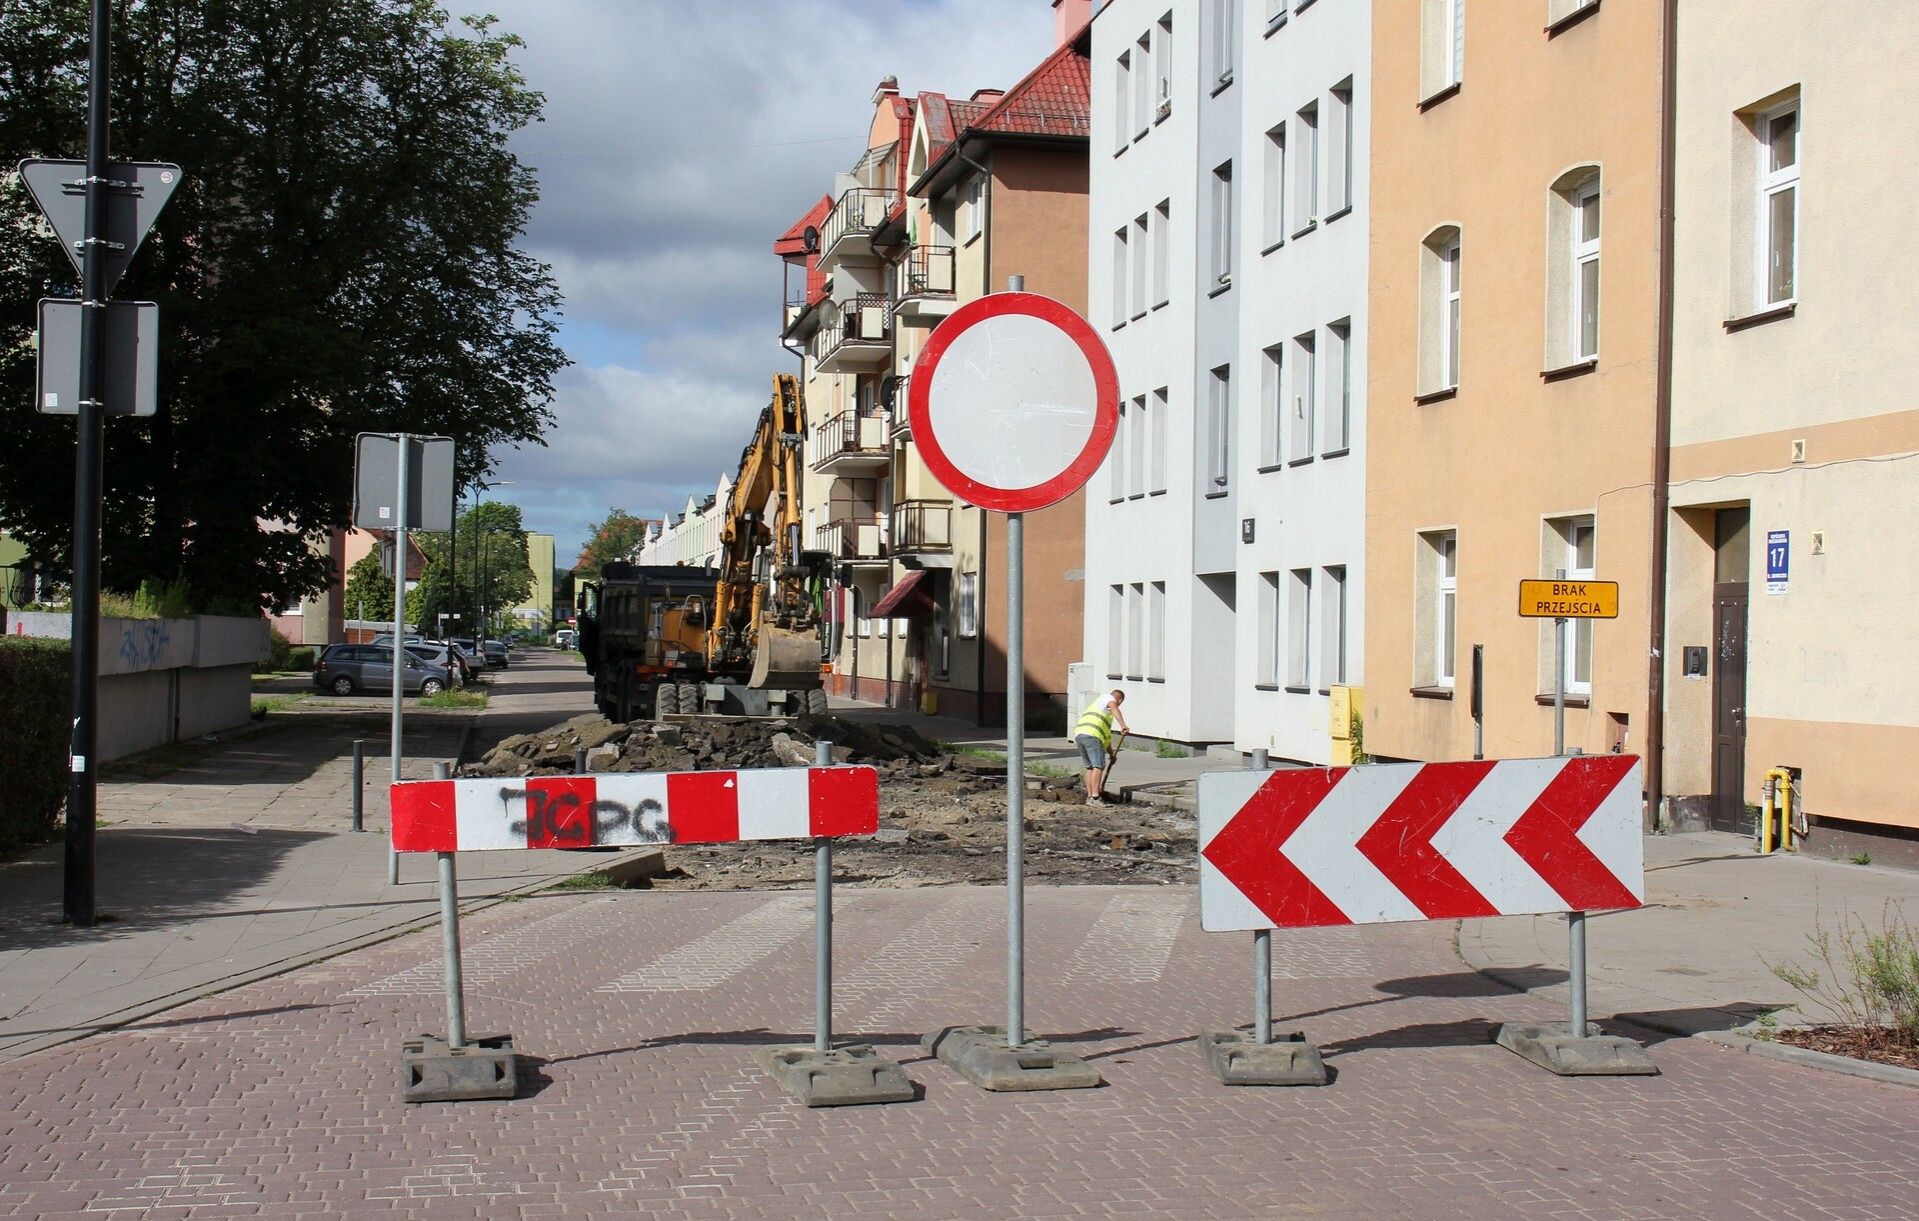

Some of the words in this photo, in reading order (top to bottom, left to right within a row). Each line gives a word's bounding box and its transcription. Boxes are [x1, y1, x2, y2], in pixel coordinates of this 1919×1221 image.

[1770, 547, 1785, 567] 17
[1552, 584, 1587, 596] BRAK
[1536, 599, 1601, 614] PRZEJŚCIA
